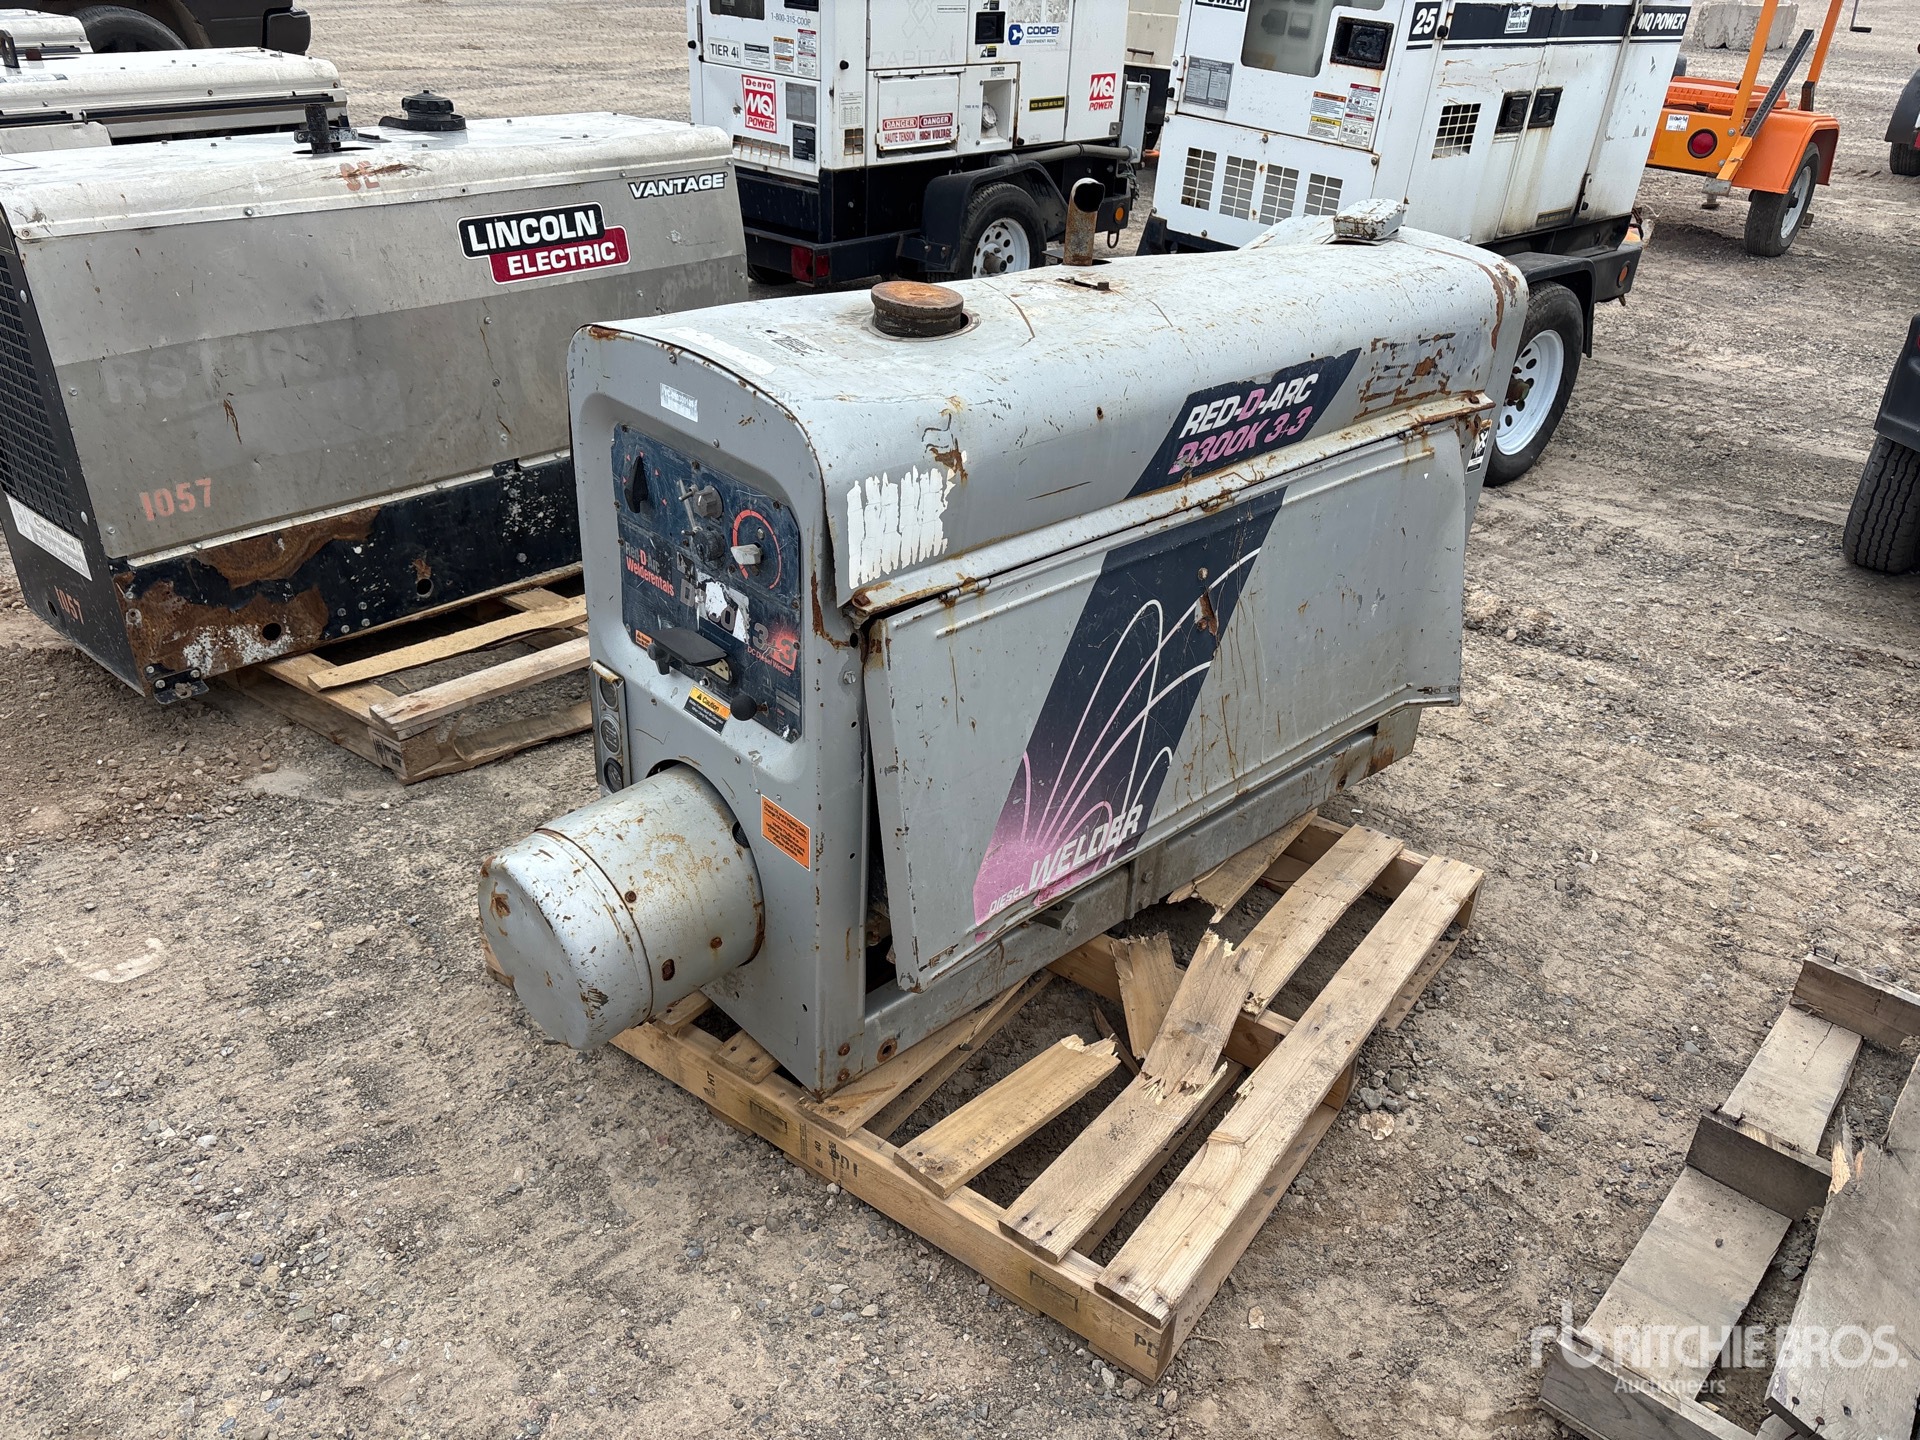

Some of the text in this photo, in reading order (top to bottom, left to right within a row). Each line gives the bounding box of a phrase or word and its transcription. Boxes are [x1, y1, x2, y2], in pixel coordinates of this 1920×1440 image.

[1412, 8, 1438, 35] 25
[1637, 13, 1687, 32] MQ POWER
[710, 43, 729, 57] TIER
[731, 47, 739, 58] 4i
[746, 79, 772, 90] Denyo
[1089, 76, 1115, 98] MQ
[746, 92, 774, 119] MQ
[1089, 101, 1113, 111] POWER
[748, 117, 774, 130] POWER
[886, 120, 915, 128] DANGER
[919, 128, 952, 140] HIGH VOLTAGE
[923, 117, 949, 125] DANGER
[629, 173, 726, 199] VANTAGE
[467, 209, 598, 252] LINCOLN
[507, 242, 616, 276] ELECTRIC
[1178, 373, 1319, 439] RED-D-ARC
[1168, 419, 1270, 475] D300K
[139, 478, 211, 521] 1057
[36, 532, 86, 571] Equipment
[626, 556, 675, 597] Welderentals
[54, 585, 84, 625] 1057
[702, 697, 720, 713] Caution
[1029, 803, 1144, 891] WELDER
[989, 883, 1025, 914] DIESEL
